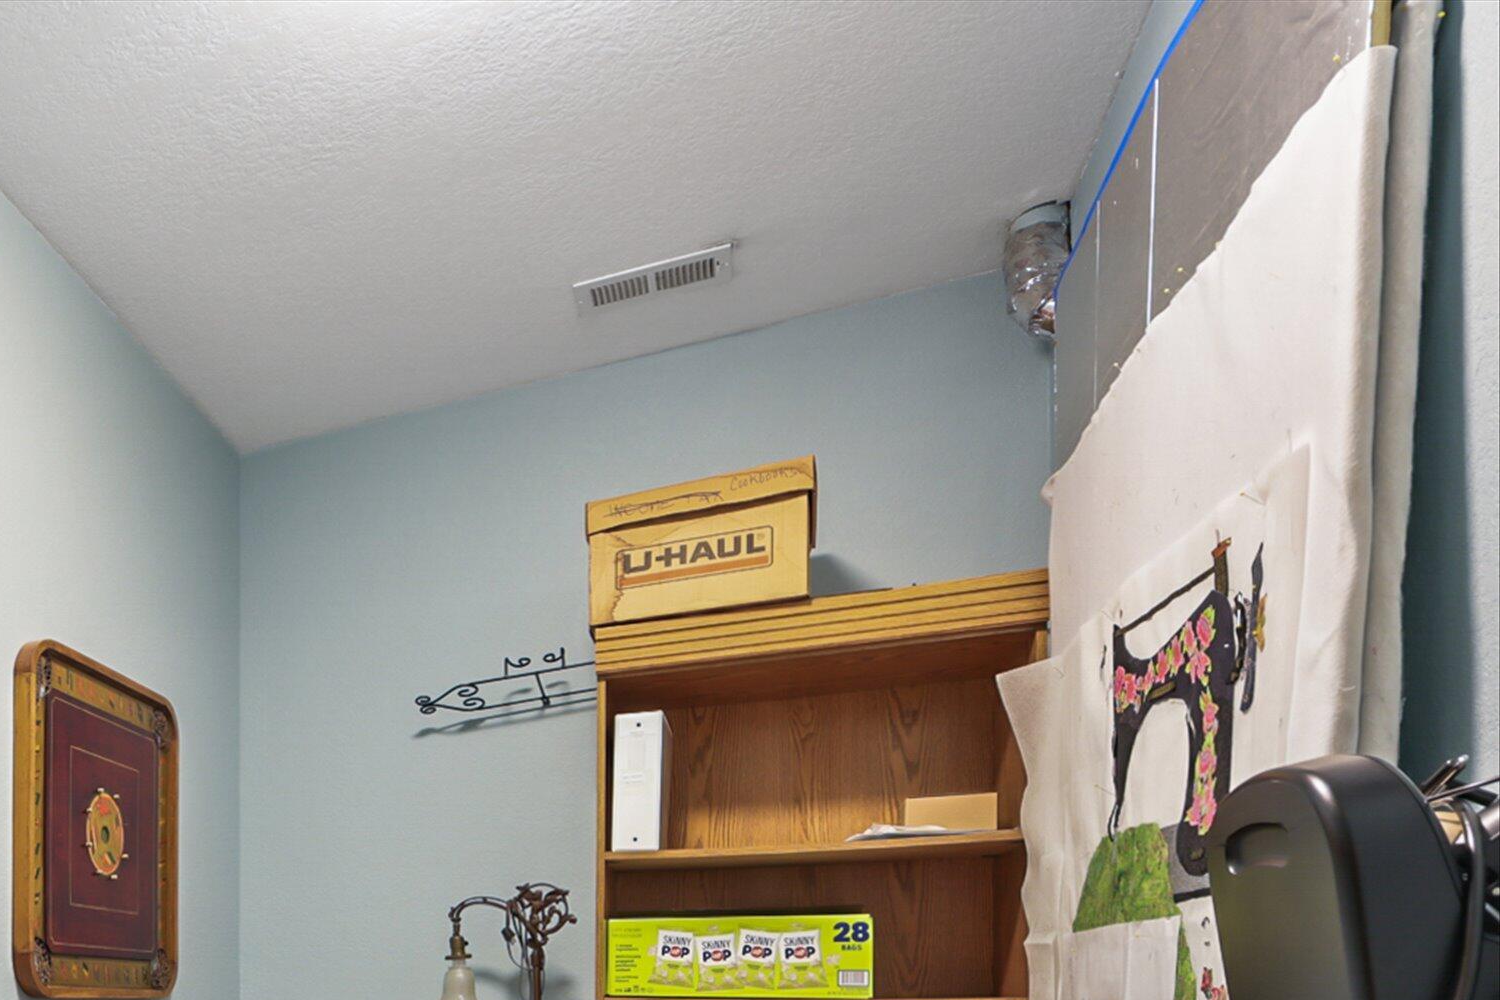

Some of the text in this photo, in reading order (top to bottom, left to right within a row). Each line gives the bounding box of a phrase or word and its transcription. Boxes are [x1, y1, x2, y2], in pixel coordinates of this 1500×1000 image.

[623, 533, 765, 574] U-HAUL
[833, 921, 869, 942] 28
[662, 945, 690, 957] POP
[703, 949, 731, 962] POP
[742, 945, 772, 958] POP
[785, 946, 816, 959] POP
